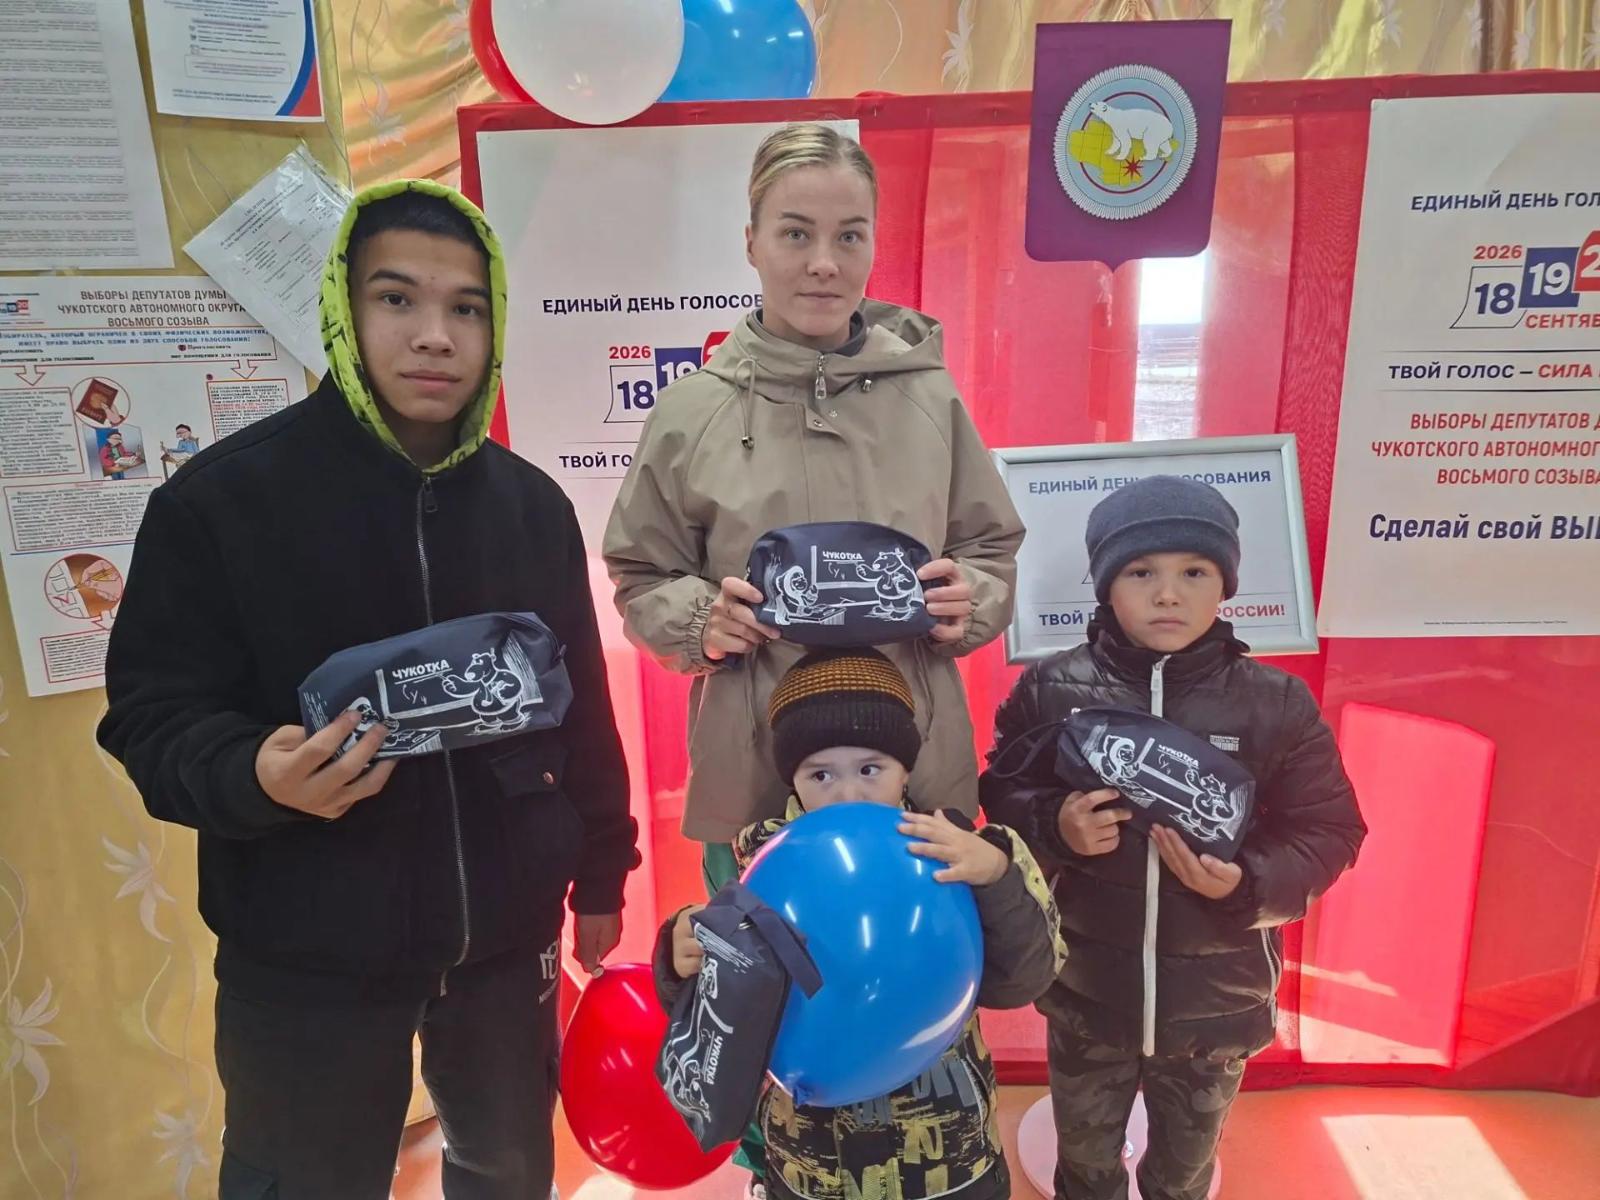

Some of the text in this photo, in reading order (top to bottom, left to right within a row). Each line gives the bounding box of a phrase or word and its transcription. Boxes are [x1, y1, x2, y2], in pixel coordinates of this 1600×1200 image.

[1411, 190, 1502, 212] ЕДИНЫЙ
[1506, 192, 1559, 210] ДЕНЬ
[1473, 244, 1522, 260] 2026
[80, 290, 227, 301] ВЫБОРЫ ДЕПУТАТОВ ДУМЫ
[1474, 282, 1516, 315] 18
[1529, 262, 1571, 296] 19
[57, 304, 126, 314] ЧУКОТСКОГО
[130, 303, 205, 313] АВТОНОМНОГО
[543, 294, 622, 314] ЕДИНЫЙ
[627, 297, 675, 313] ДЕНЬ
[108, 316, 210, 327] ВОСЬМОГО СОЗЫВА
[608, 346, 652, 359] 2026
[1388, 361, 1441, 379] ТВОЙ
[1446, 364, 1515, 379] ГОЛОС
[1538, 363, 1593, 379] СИЛА
[617, 380, 655, 410] 18
[1411, 413, 1487, 430] ВЫБОРЫ
[1491, 412, 1590, 431] ДЕПУТАТОВ
[1371, 441, 1479, 457] ЧУКОТСКОГО
[559, 451, 607, 468] ТВОЙ
[1029, 476, 1098, 494] ЕДИНЫЙ
[1437, 468, 1529, 485] ВОСЬМОГО
[1369, 513, 1470, 542] Сделай
[1477, 513, 1543, 540] свой
[822, 550, 863, 560] ЧУКОТКА
[1039, 608, 1084, 626] ТВОЙ
[392, 659, 450, 680] ЧУКОТКА
